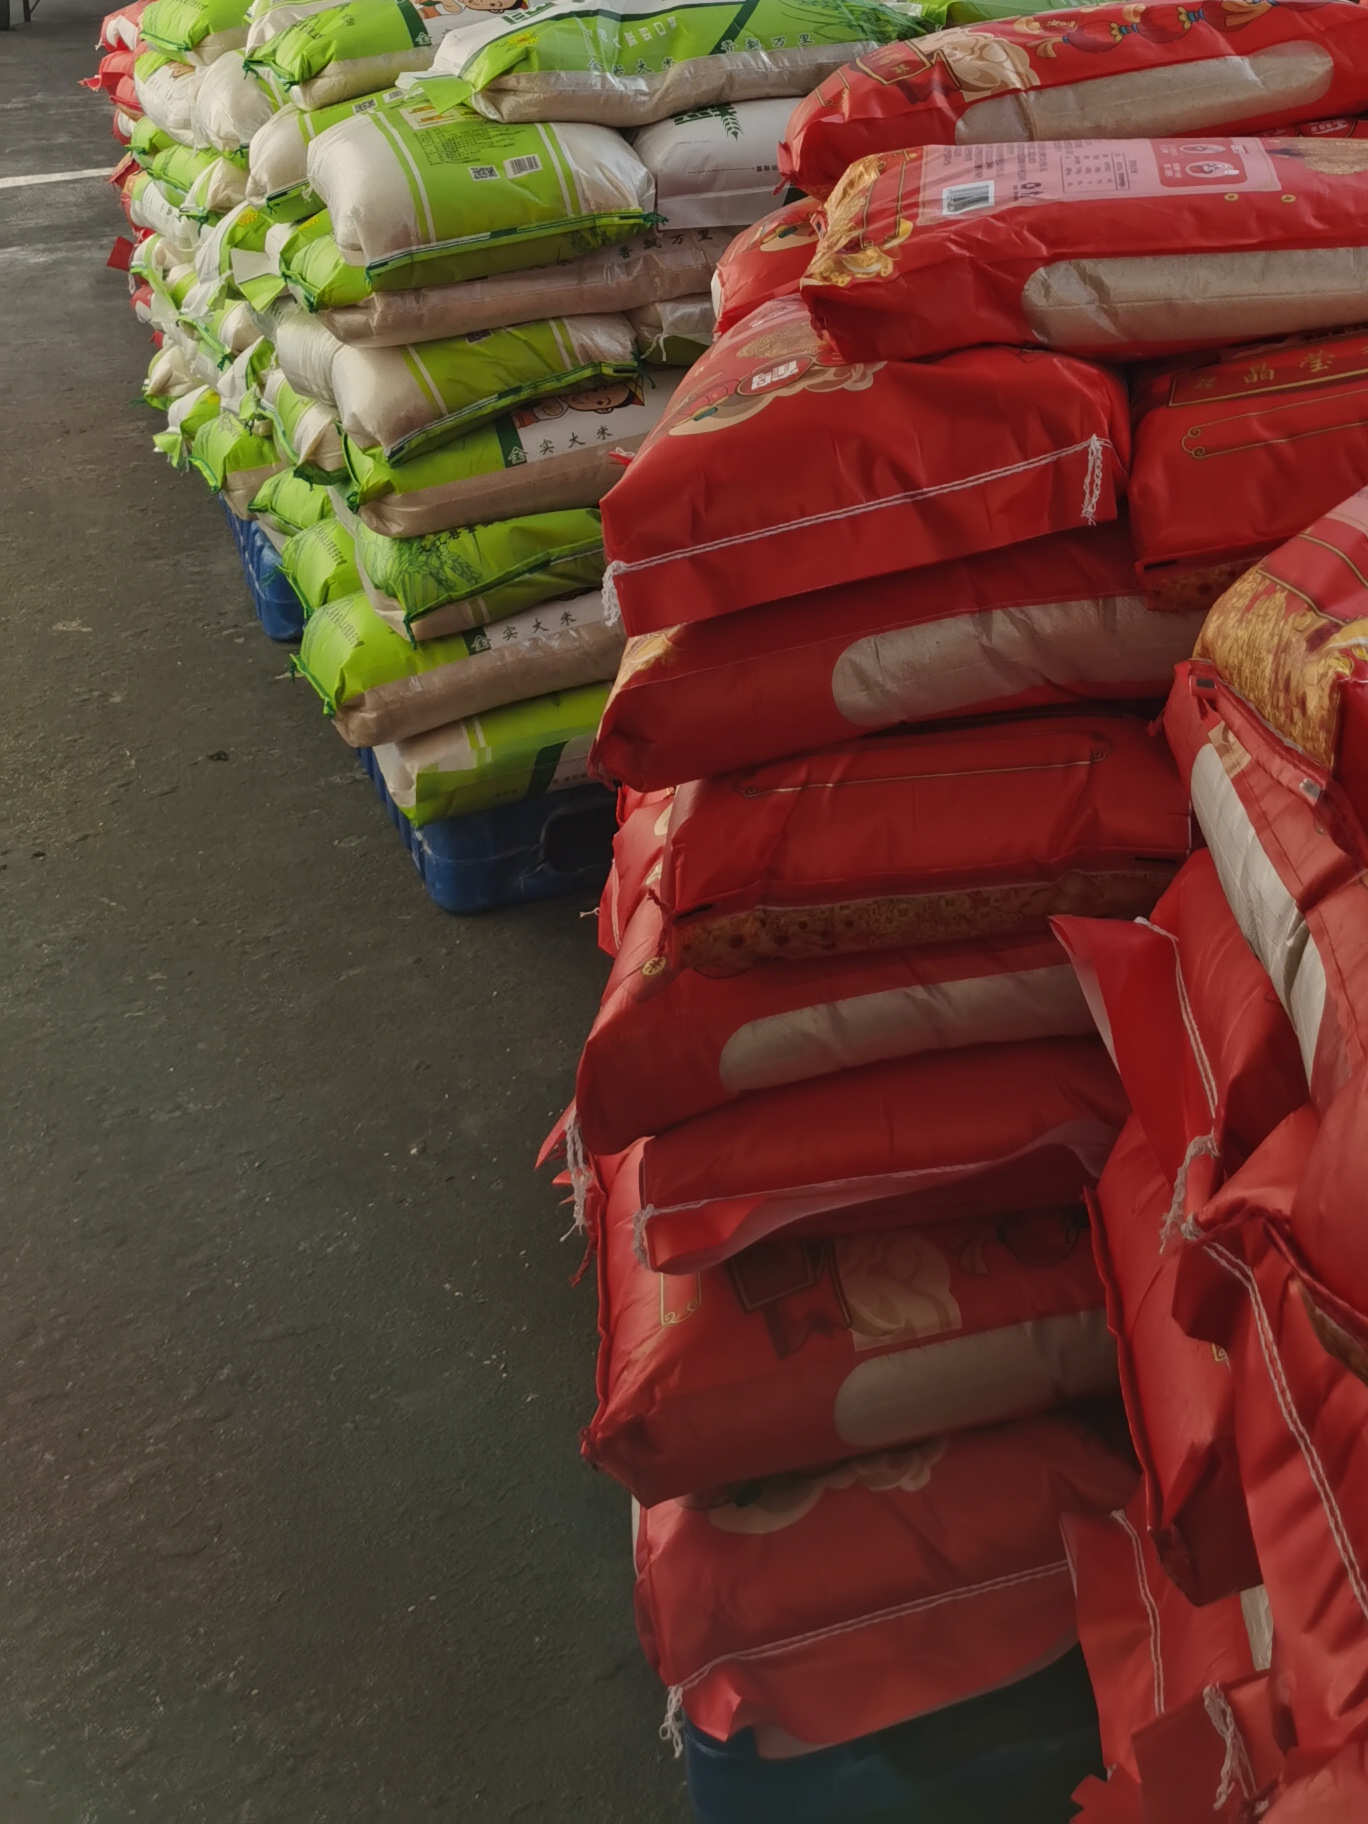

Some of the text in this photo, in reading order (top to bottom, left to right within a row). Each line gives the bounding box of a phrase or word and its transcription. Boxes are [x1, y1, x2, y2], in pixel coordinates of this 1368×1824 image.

[508, 424, 613, 465] 金实大米
[471, 610, 577, 652] 金实大米
